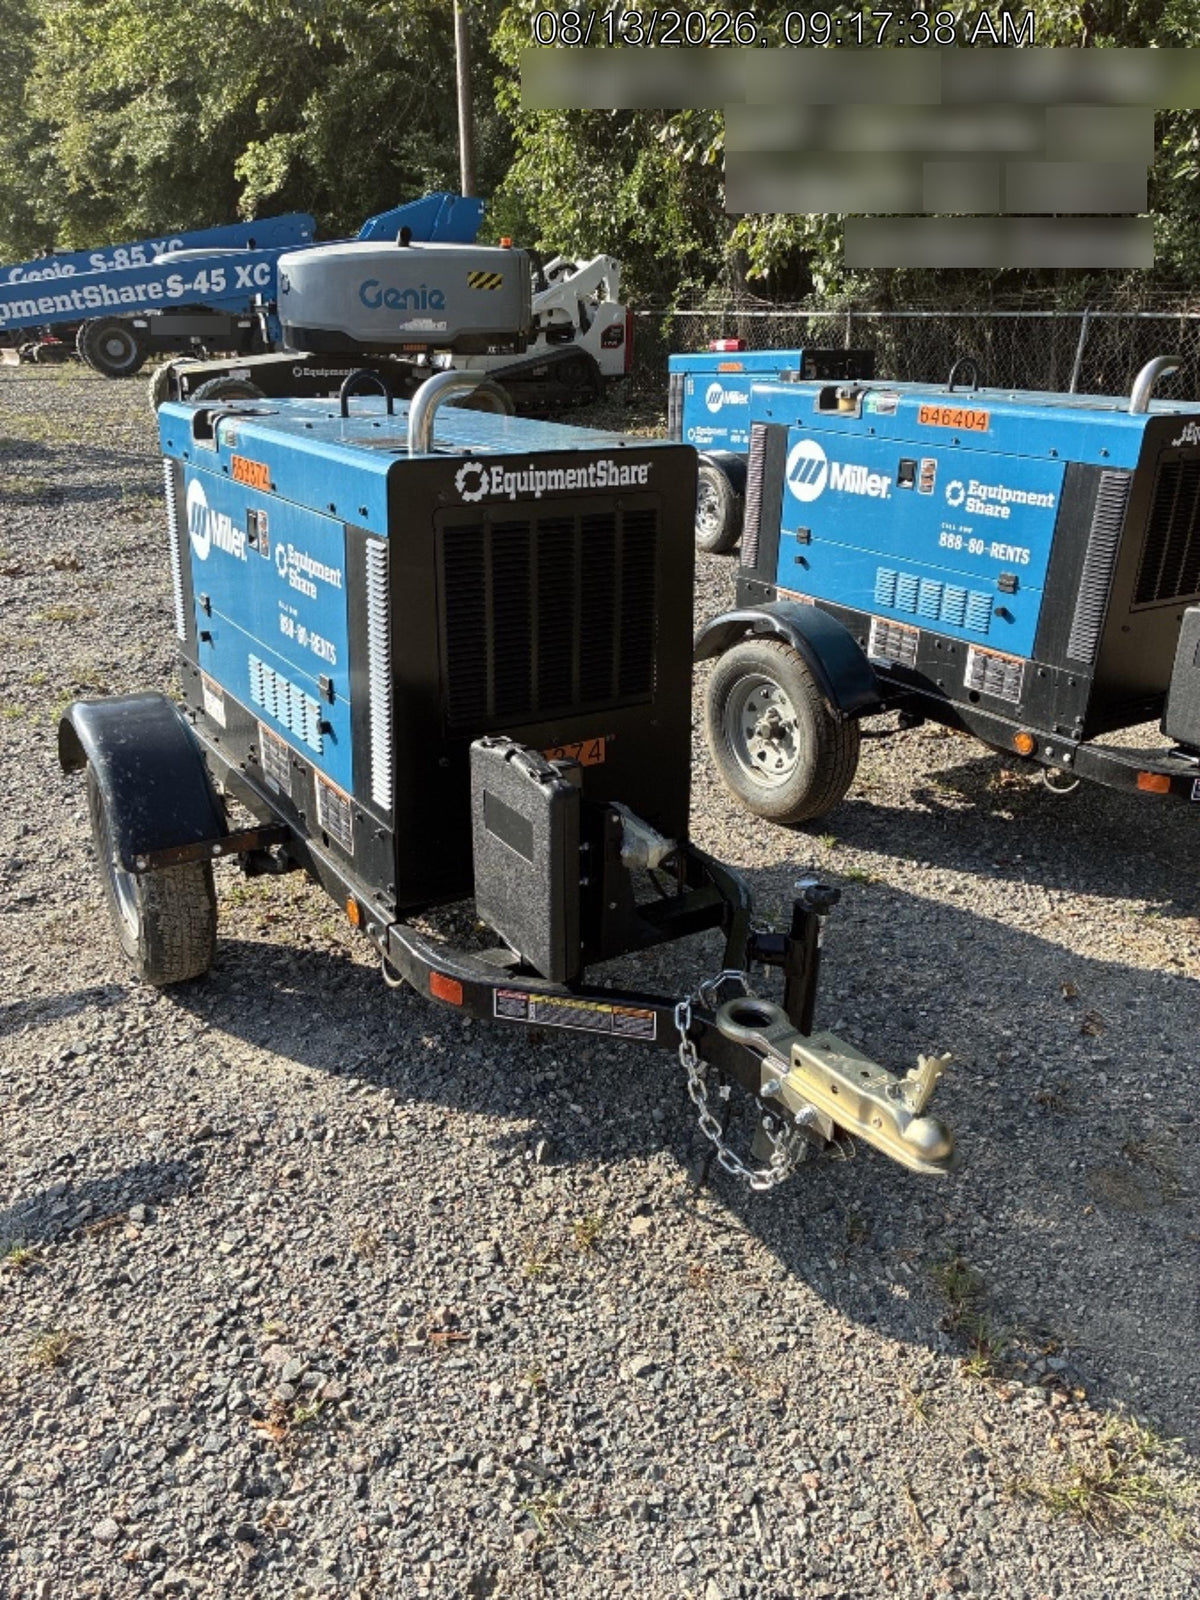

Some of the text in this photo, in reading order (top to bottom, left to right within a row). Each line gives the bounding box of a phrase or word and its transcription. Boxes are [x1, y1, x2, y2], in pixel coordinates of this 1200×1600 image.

[89, 245, 147, 272] S-85
[166, 262, 271, 298] S-45 XC
[358, 278, 445, 310] Genie
[920, 406, 987, 430] 646404
[490, 460, 648, 499] EquipmentShare
[967, 480, 1055, 507] Equipment
[965, 498, 1011, 519] Share
[938, 532, 1030, 565] 888-80-RENTS
[287, 543, 342, 589] Equipment
